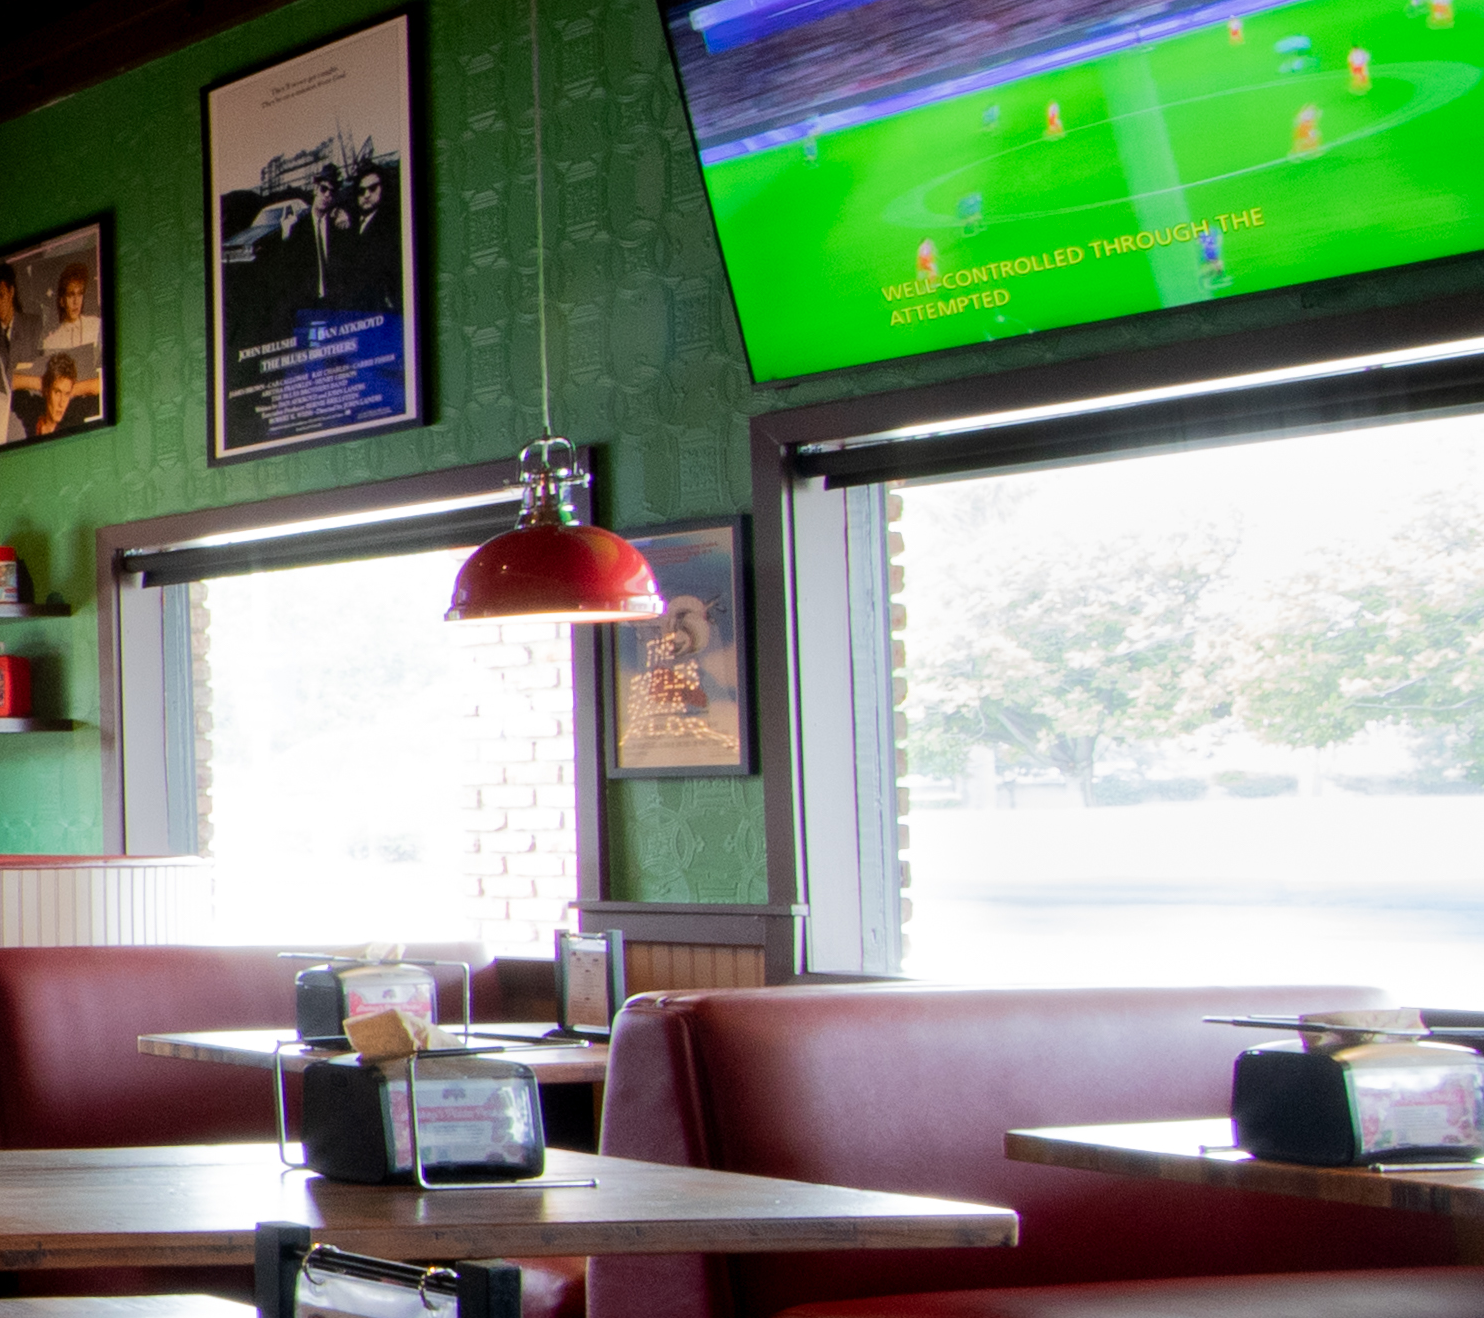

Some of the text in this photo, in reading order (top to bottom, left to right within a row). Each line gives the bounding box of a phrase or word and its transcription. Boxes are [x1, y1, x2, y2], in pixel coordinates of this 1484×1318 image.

[1089, 218, 1210, 260] THROUGH
[1215, 206, 1266, 233] THE
[889, 287, 1011, 327] ATTEMPTED
[338, 315, 385, 337] AYKROYD
[238, 337, 298, 362] JOHN BELUSHI
[260, 338, 358, 373] THE BLUES BROTHERS
